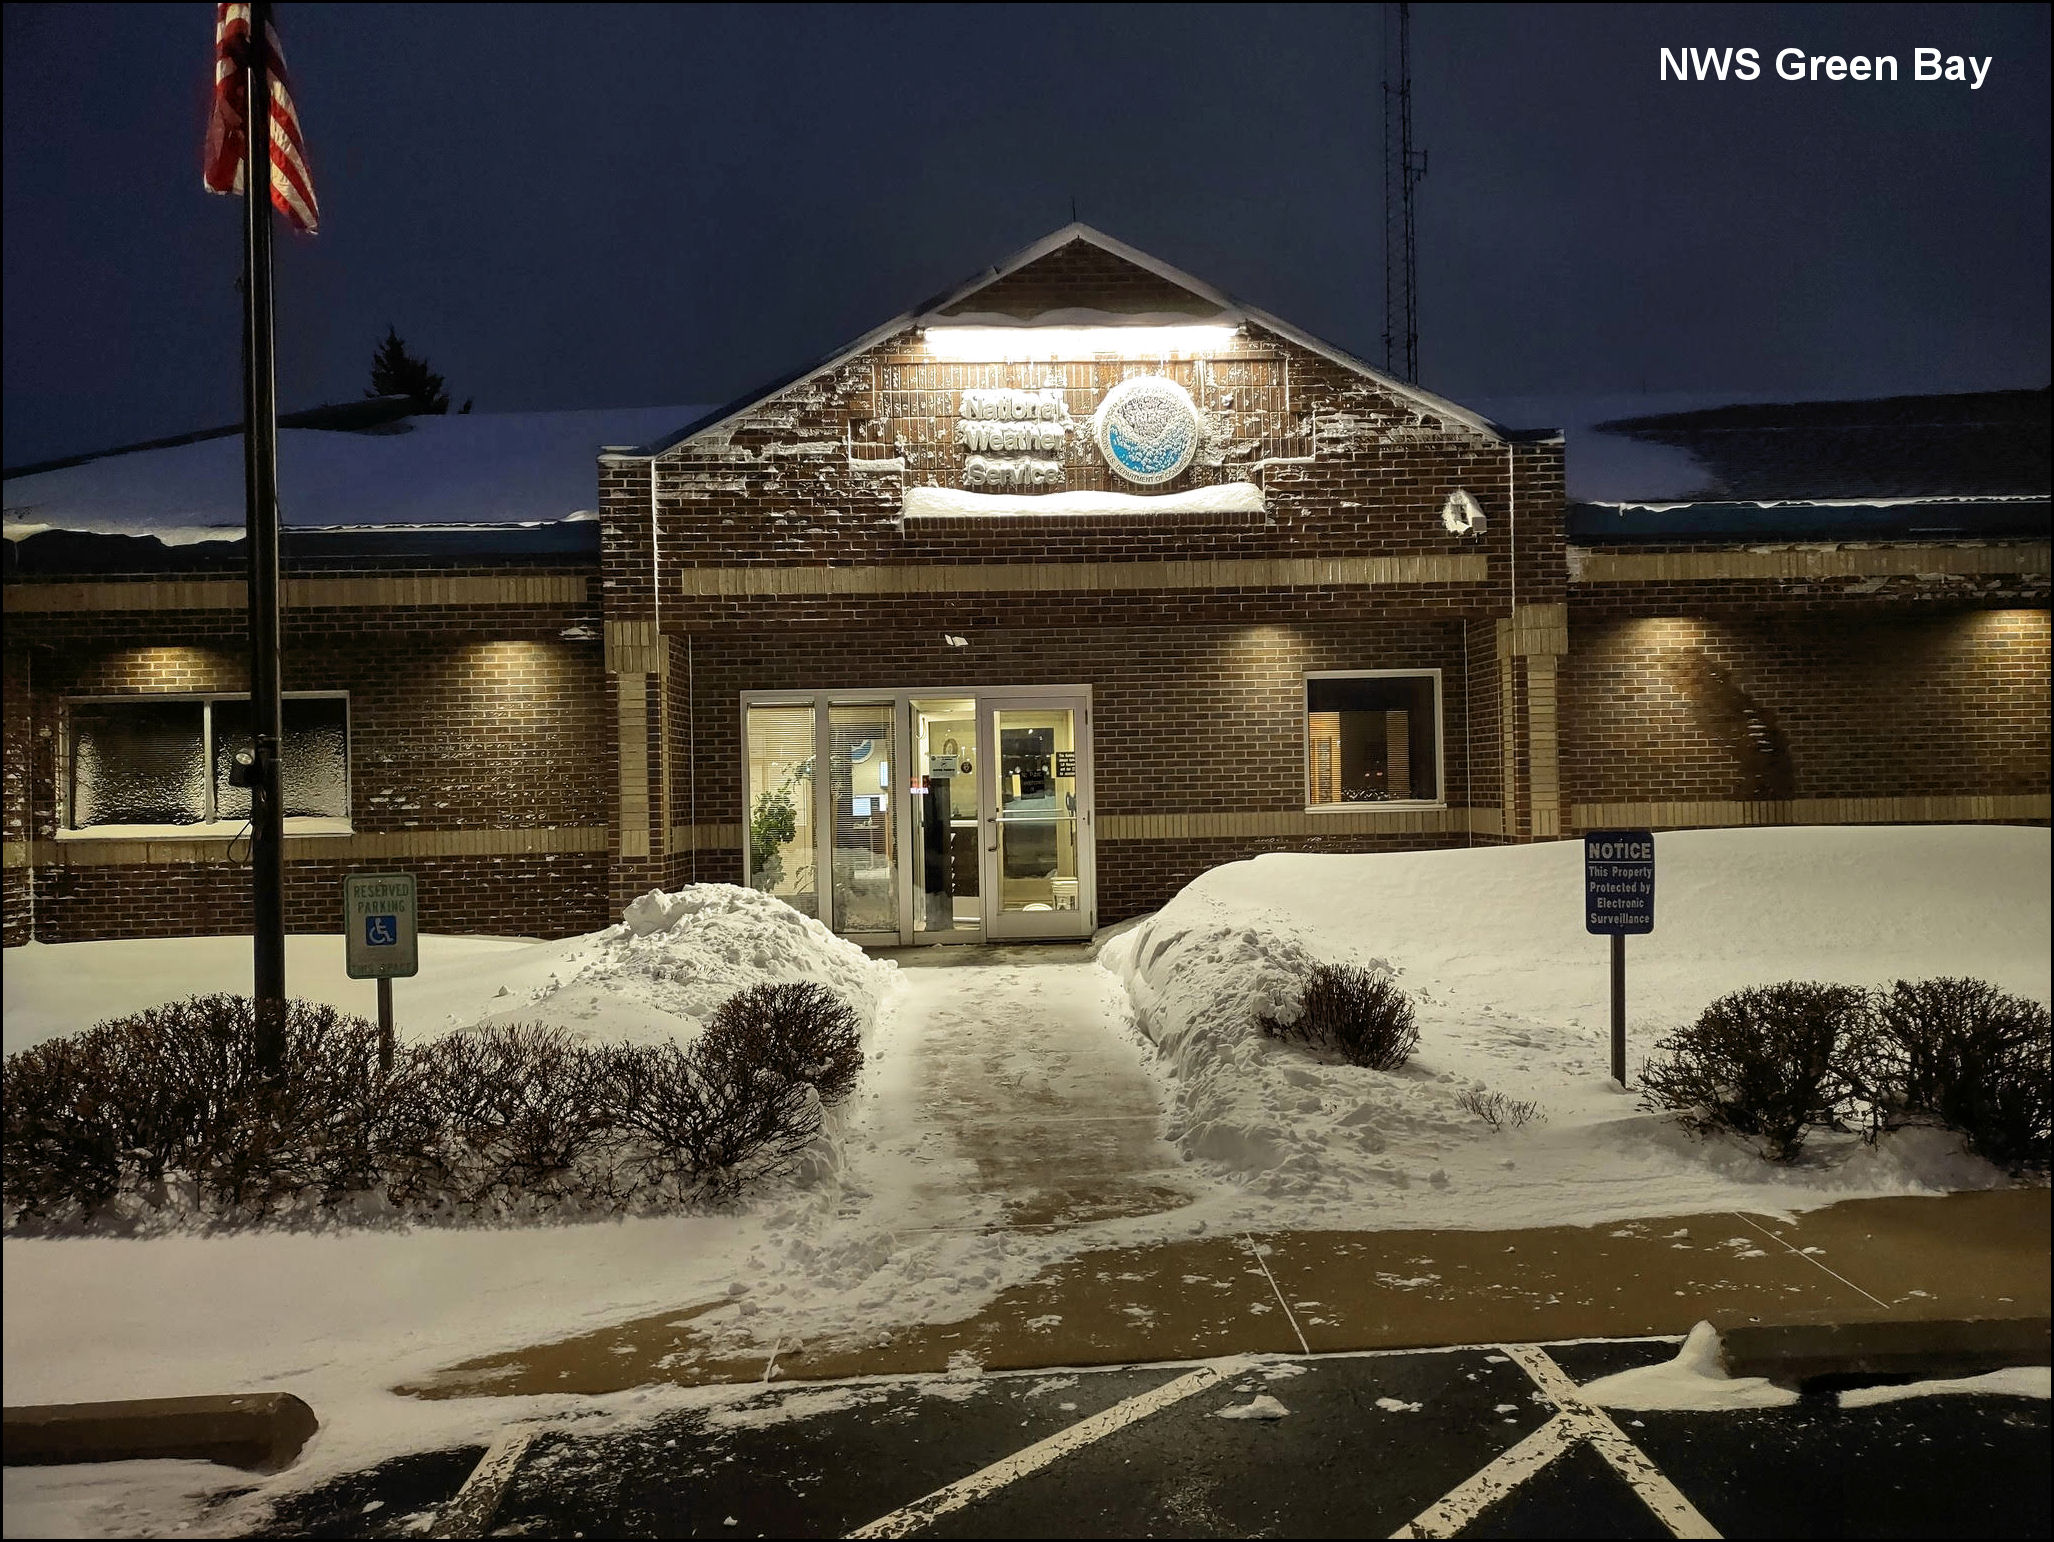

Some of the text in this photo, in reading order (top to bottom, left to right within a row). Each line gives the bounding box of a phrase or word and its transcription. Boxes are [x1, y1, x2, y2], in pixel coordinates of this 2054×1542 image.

[964, 395, 1062, 419] National
[965, 427, 1063, 451] Weather
[968, 463, 1059, 485] Service
[1115, 463, 1155, 483] DEPARTMENT
[1155, 474, 1165, 482] OF
[1588, 842, 1652, 859] NOTICE
[1588, 866, 1653, 879] This Property
[353, 883, 409, 898] RESERVED
[1589, 881, 1652, 894] Protected by
[357, 900, 406, 913] PARKING
[1597, 897, 1645, 908] Electronic
[1590, 912, 1651, 924] Surveillance
